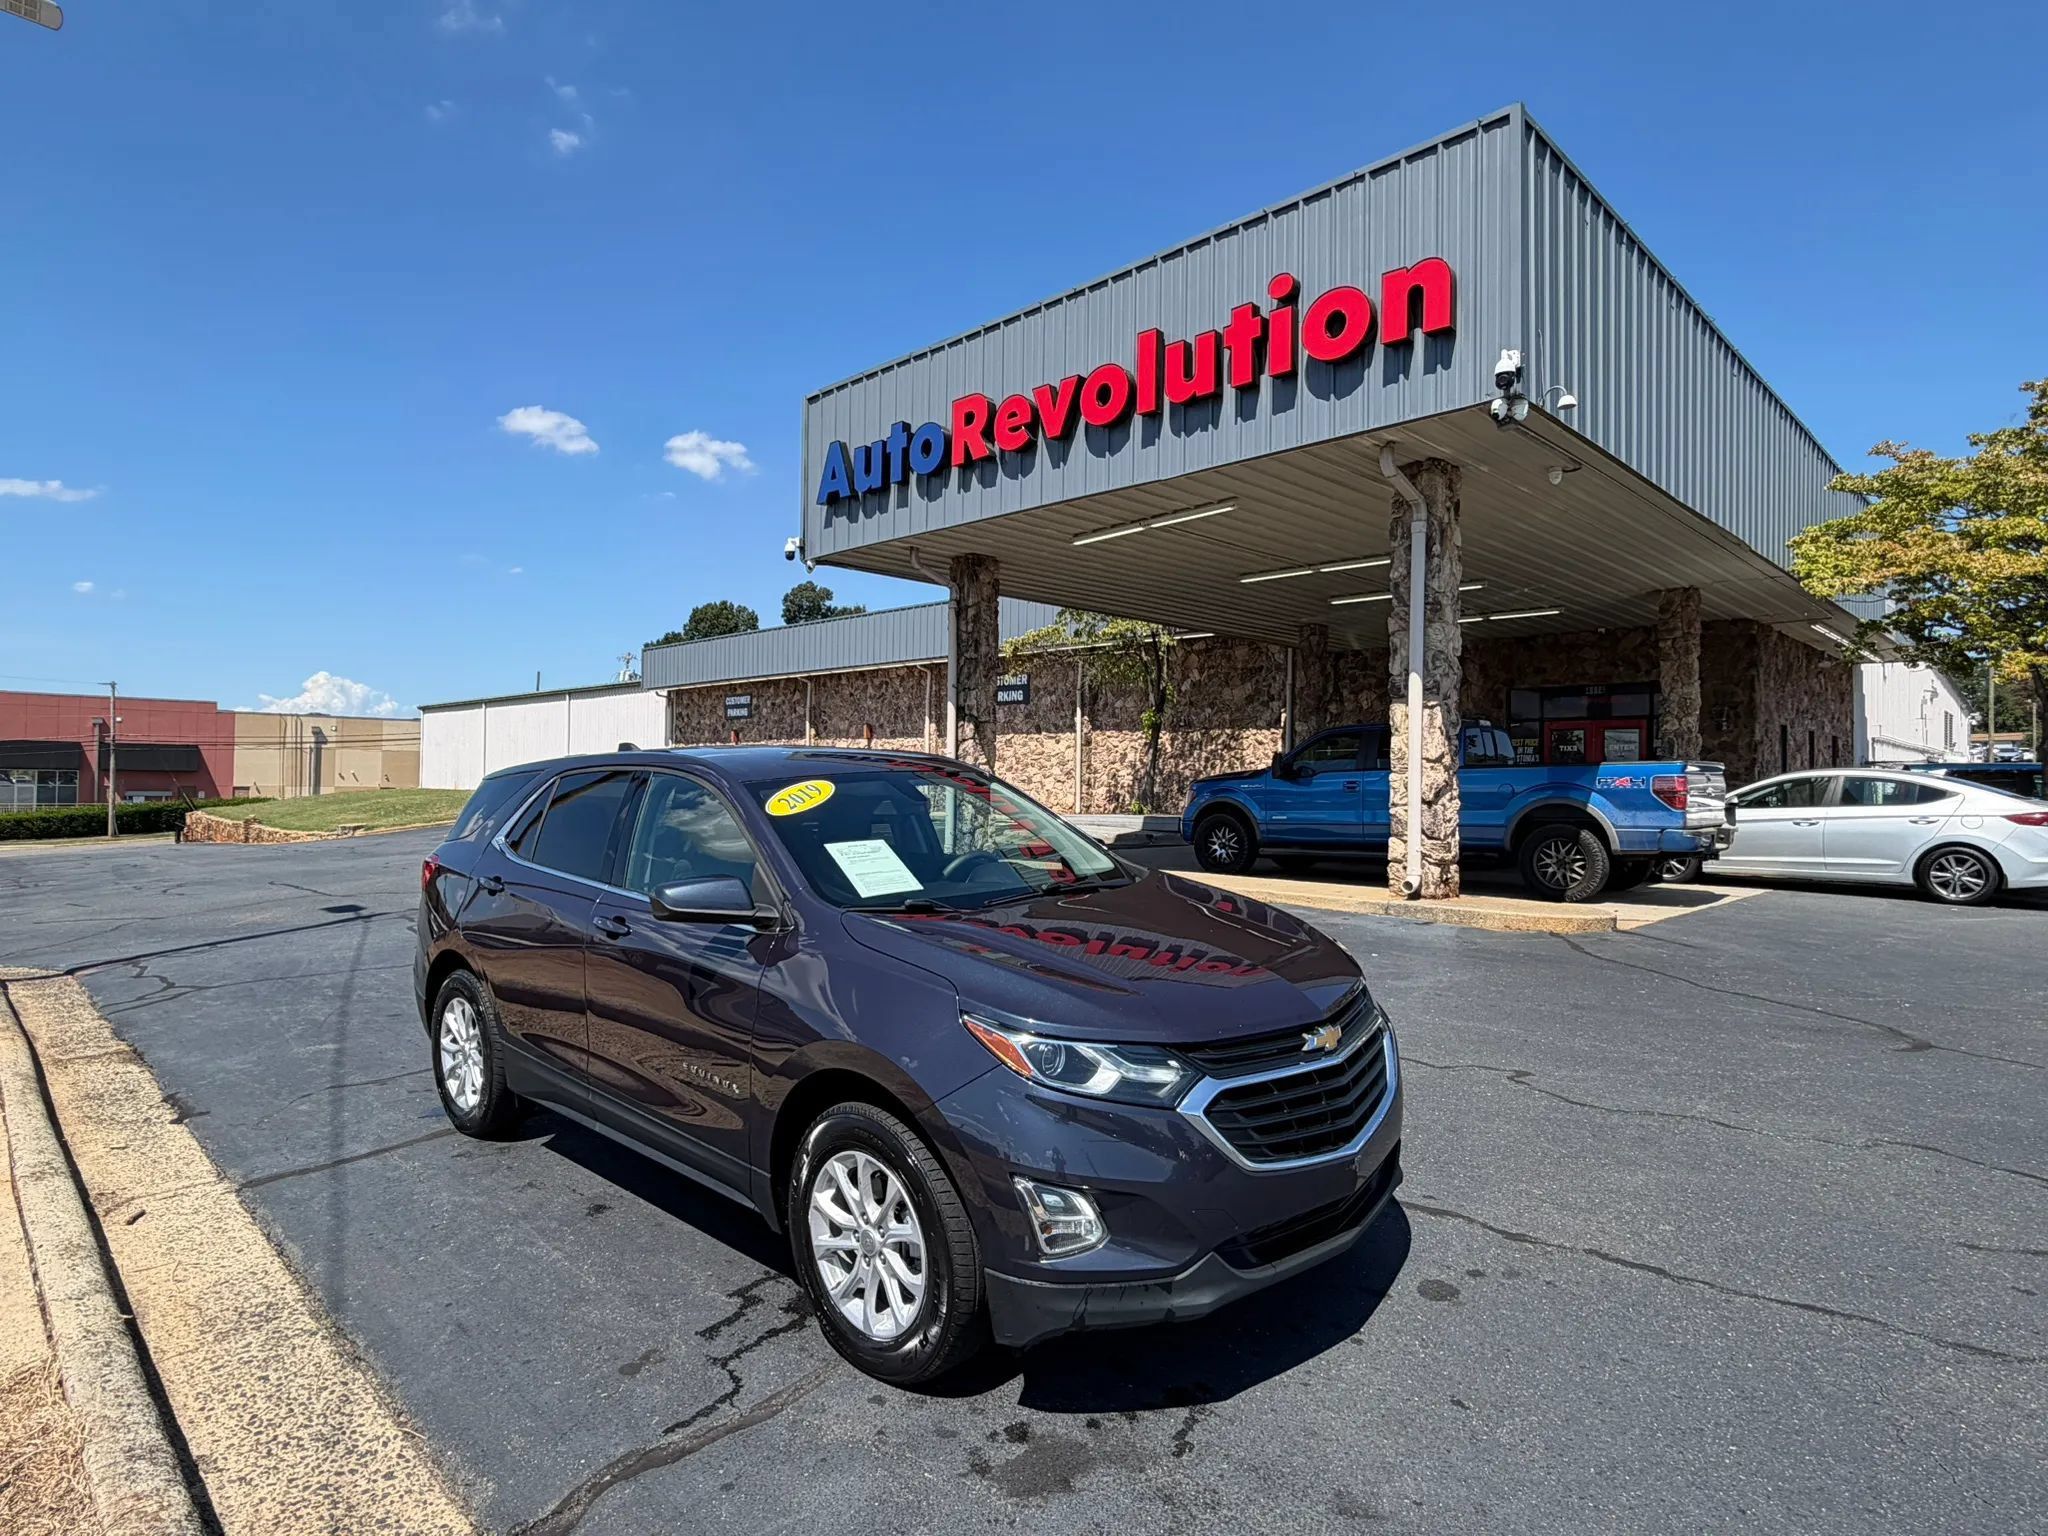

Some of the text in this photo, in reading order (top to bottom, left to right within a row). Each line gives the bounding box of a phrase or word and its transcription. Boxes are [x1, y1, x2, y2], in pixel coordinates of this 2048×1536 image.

[997, 674, 1028, 687] STOMER
[725, 695, 751, 706] CUSTOMER
[997, 690, 1024, 702] RKING
[727, 707, 748, 717] PARKING
[777, 784, 822, 810] 2019
